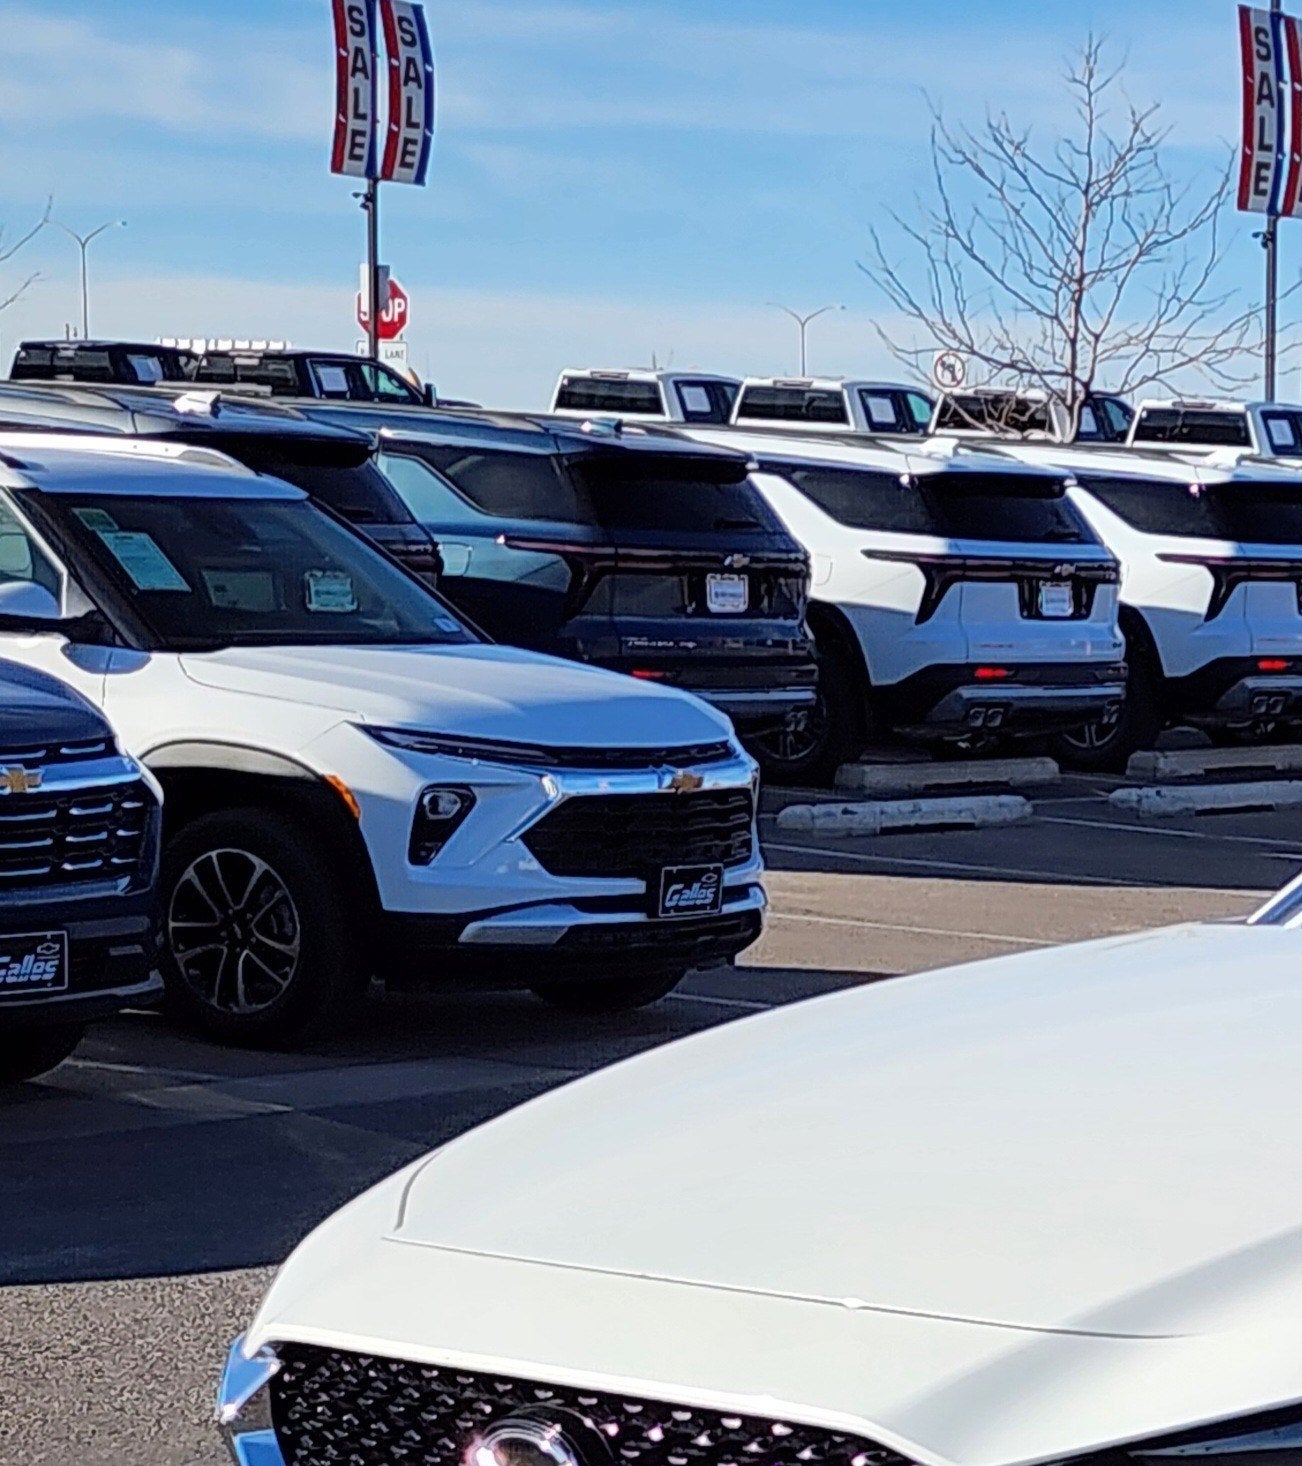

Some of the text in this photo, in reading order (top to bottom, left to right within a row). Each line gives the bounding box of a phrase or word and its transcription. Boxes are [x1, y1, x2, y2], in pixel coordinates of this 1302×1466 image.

[347, 5, 370, 162] SALE
[397, 15, 423, 170] SALE
[1253, 26, 1275, 197] SALE
